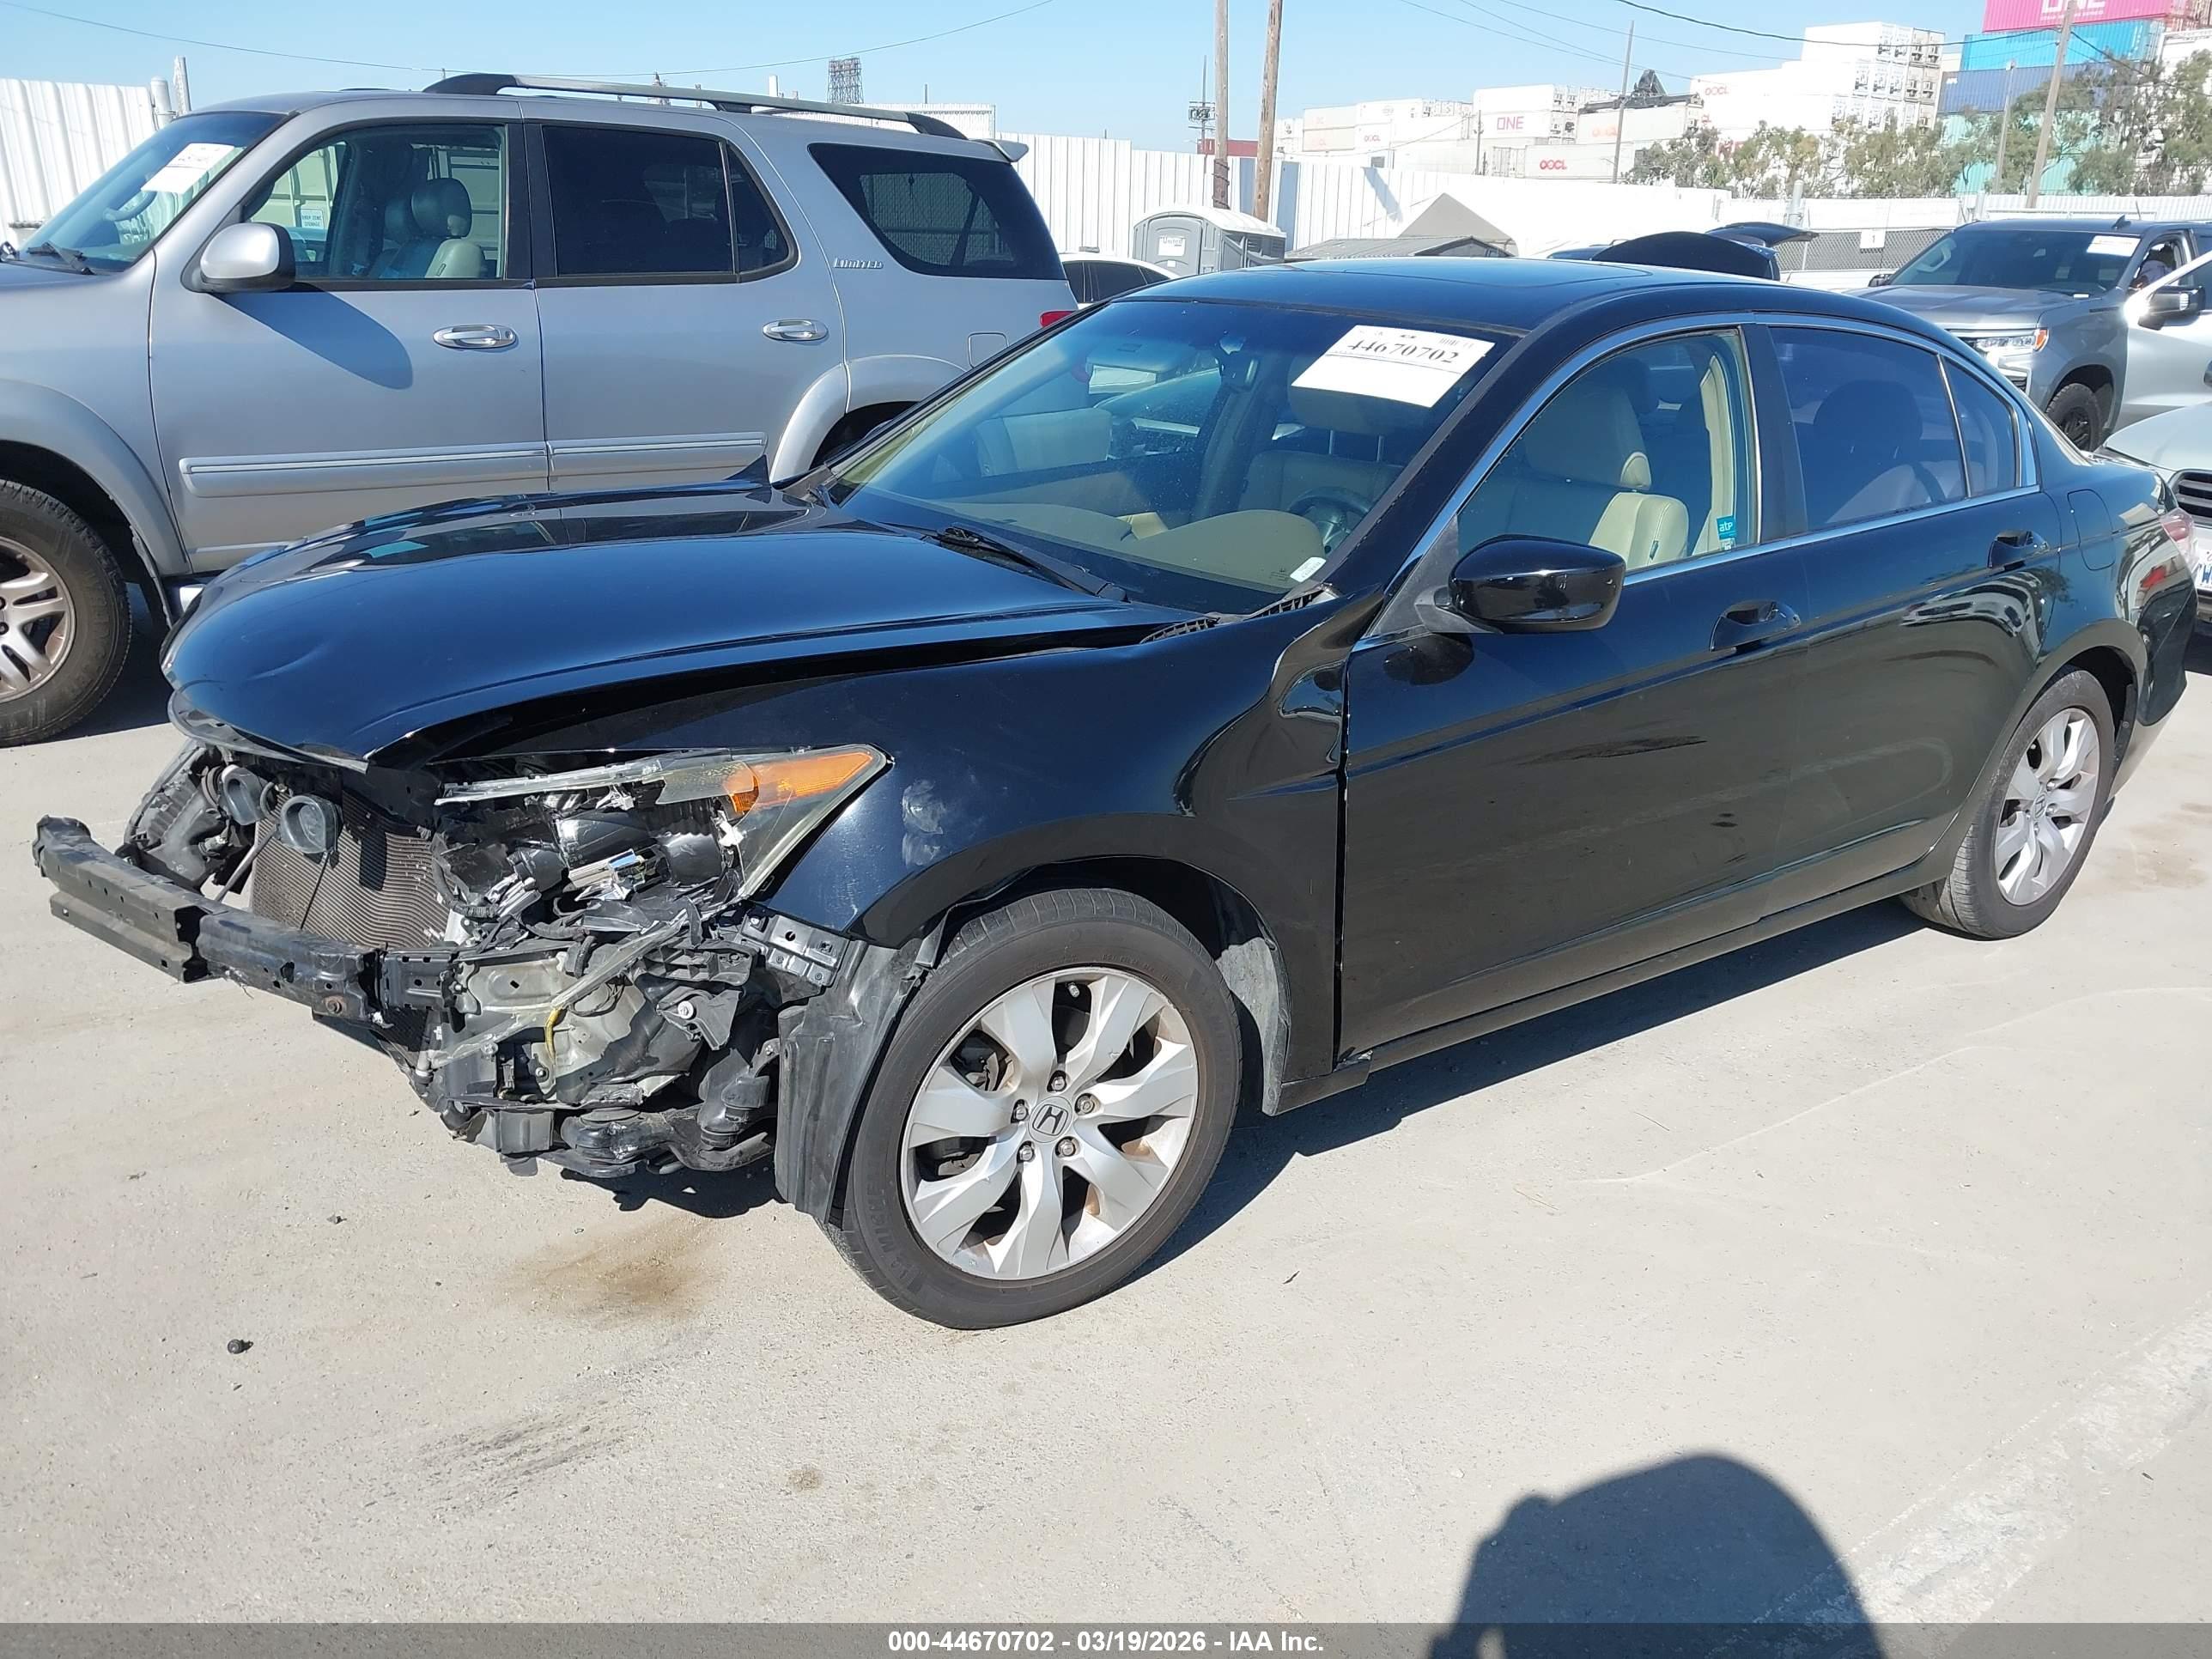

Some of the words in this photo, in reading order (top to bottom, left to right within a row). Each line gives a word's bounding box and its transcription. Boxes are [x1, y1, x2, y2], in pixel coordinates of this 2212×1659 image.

[1497, 116, 1523, 131] ONE
[1540, 159, 1567, 170] OOCL
[1347, 339, 1459, 363] 44670702
